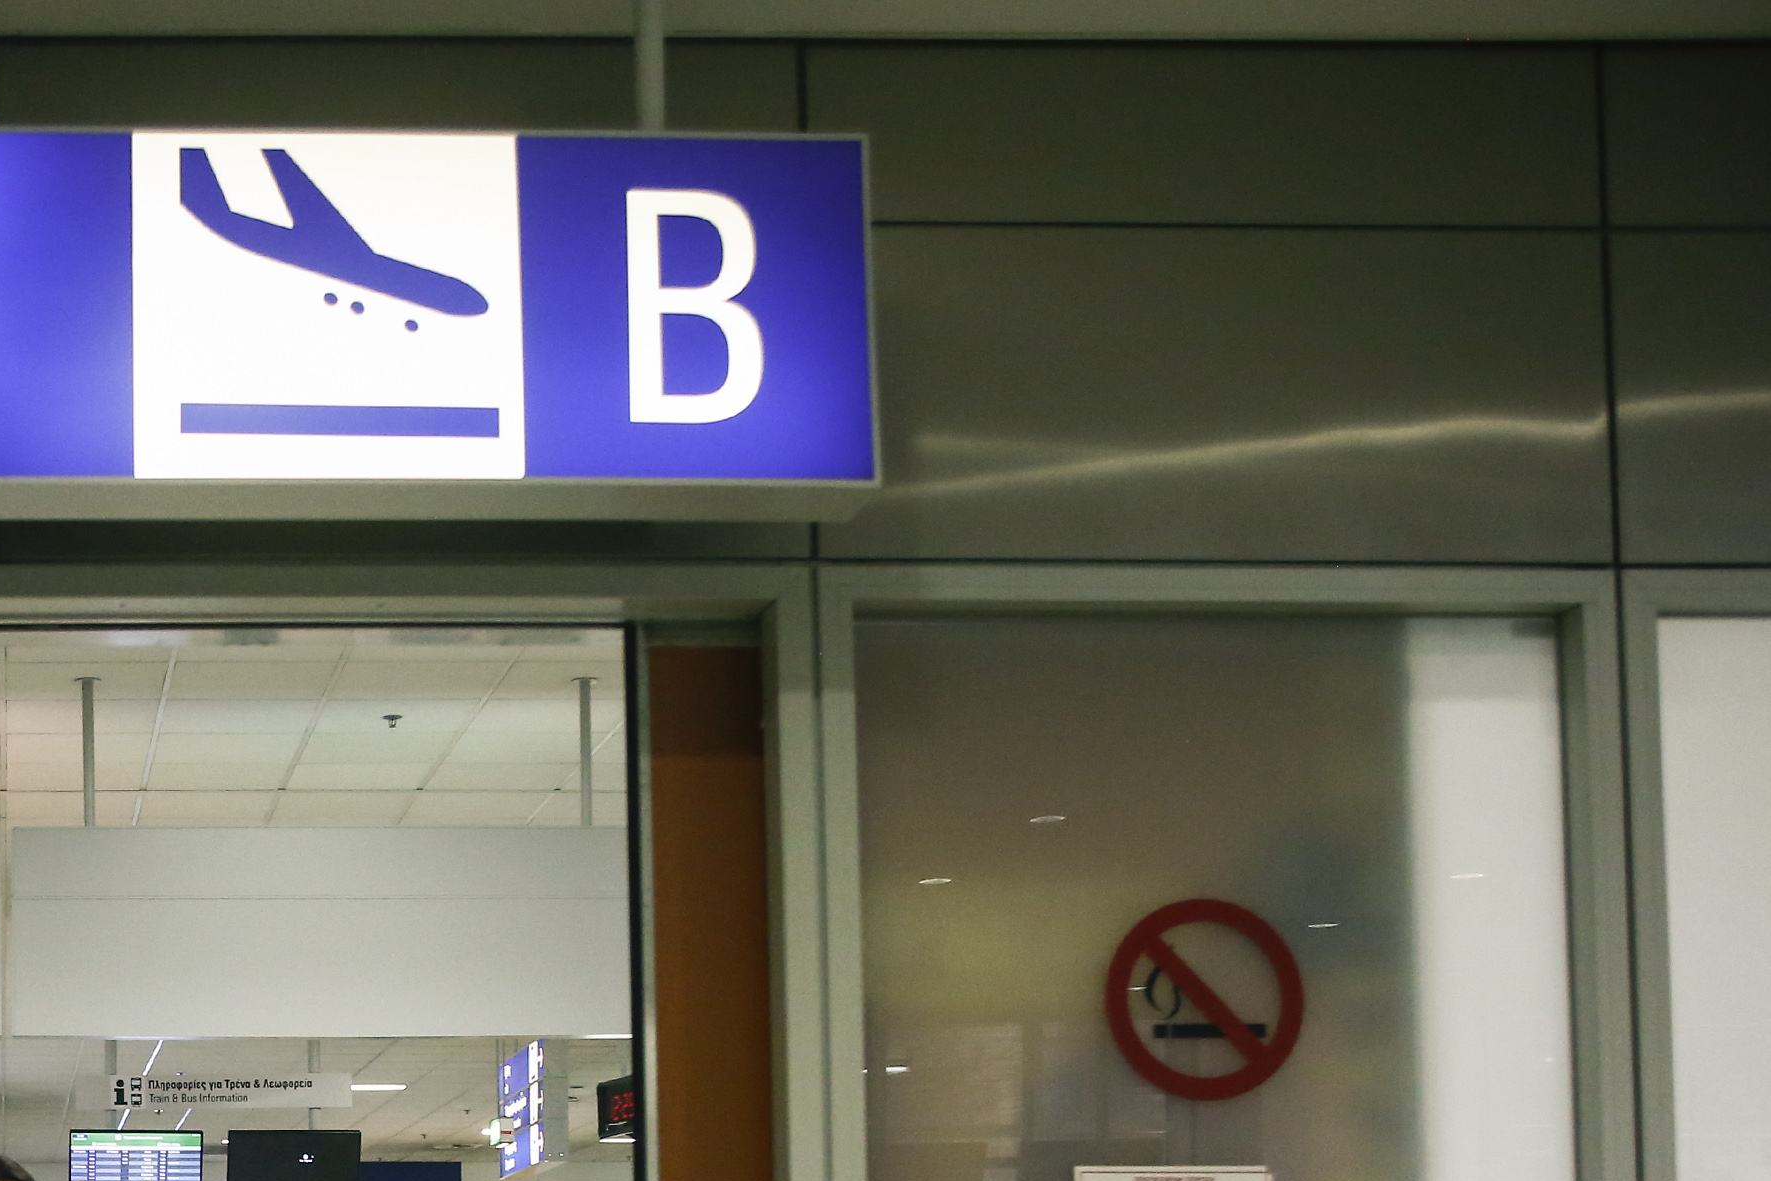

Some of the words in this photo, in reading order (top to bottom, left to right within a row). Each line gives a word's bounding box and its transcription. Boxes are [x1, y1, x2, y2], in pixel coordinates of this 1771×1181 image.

[625, 187, 765, 424] B
[148, 1079, 206, 1091] Πληροφορίες
[209, 1081, 222, 1091] για
[224, 1078, 251, 1090] Τρένα
[253, 1079, 260, 1088] &
[263, 1077, 313, 1090] Λεωφορεία
[149, 1093, 170, 1103] Train
[172, 1094, 178, 1103] &
[181, 1094, 197, 1103] Bus
[199, 1092, 248, 1103] Information
